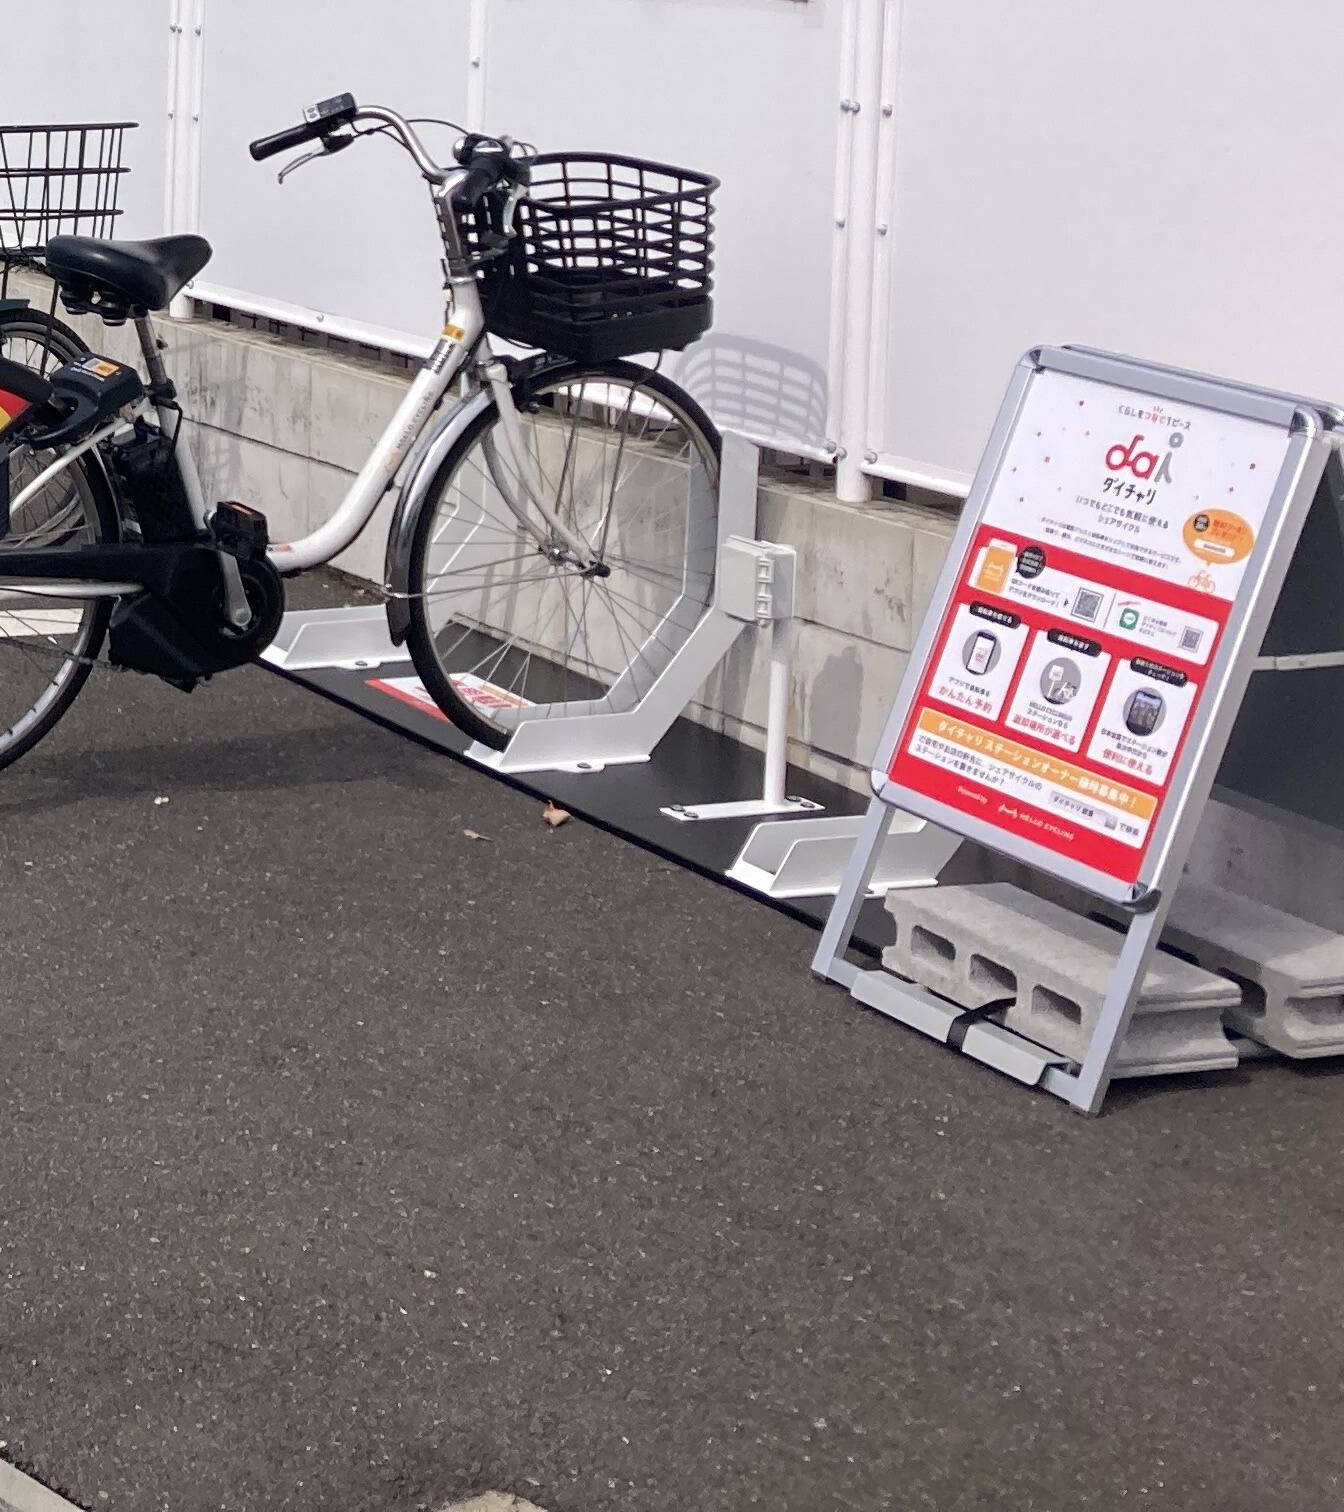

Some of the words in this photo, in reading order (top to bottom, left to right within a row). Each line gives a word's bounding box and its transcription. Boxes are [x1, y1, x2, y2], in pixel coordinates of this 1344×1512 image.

[1105, 432, 1184, 484] dai
[1101, 475, 1156, 506] ダイチャリ
